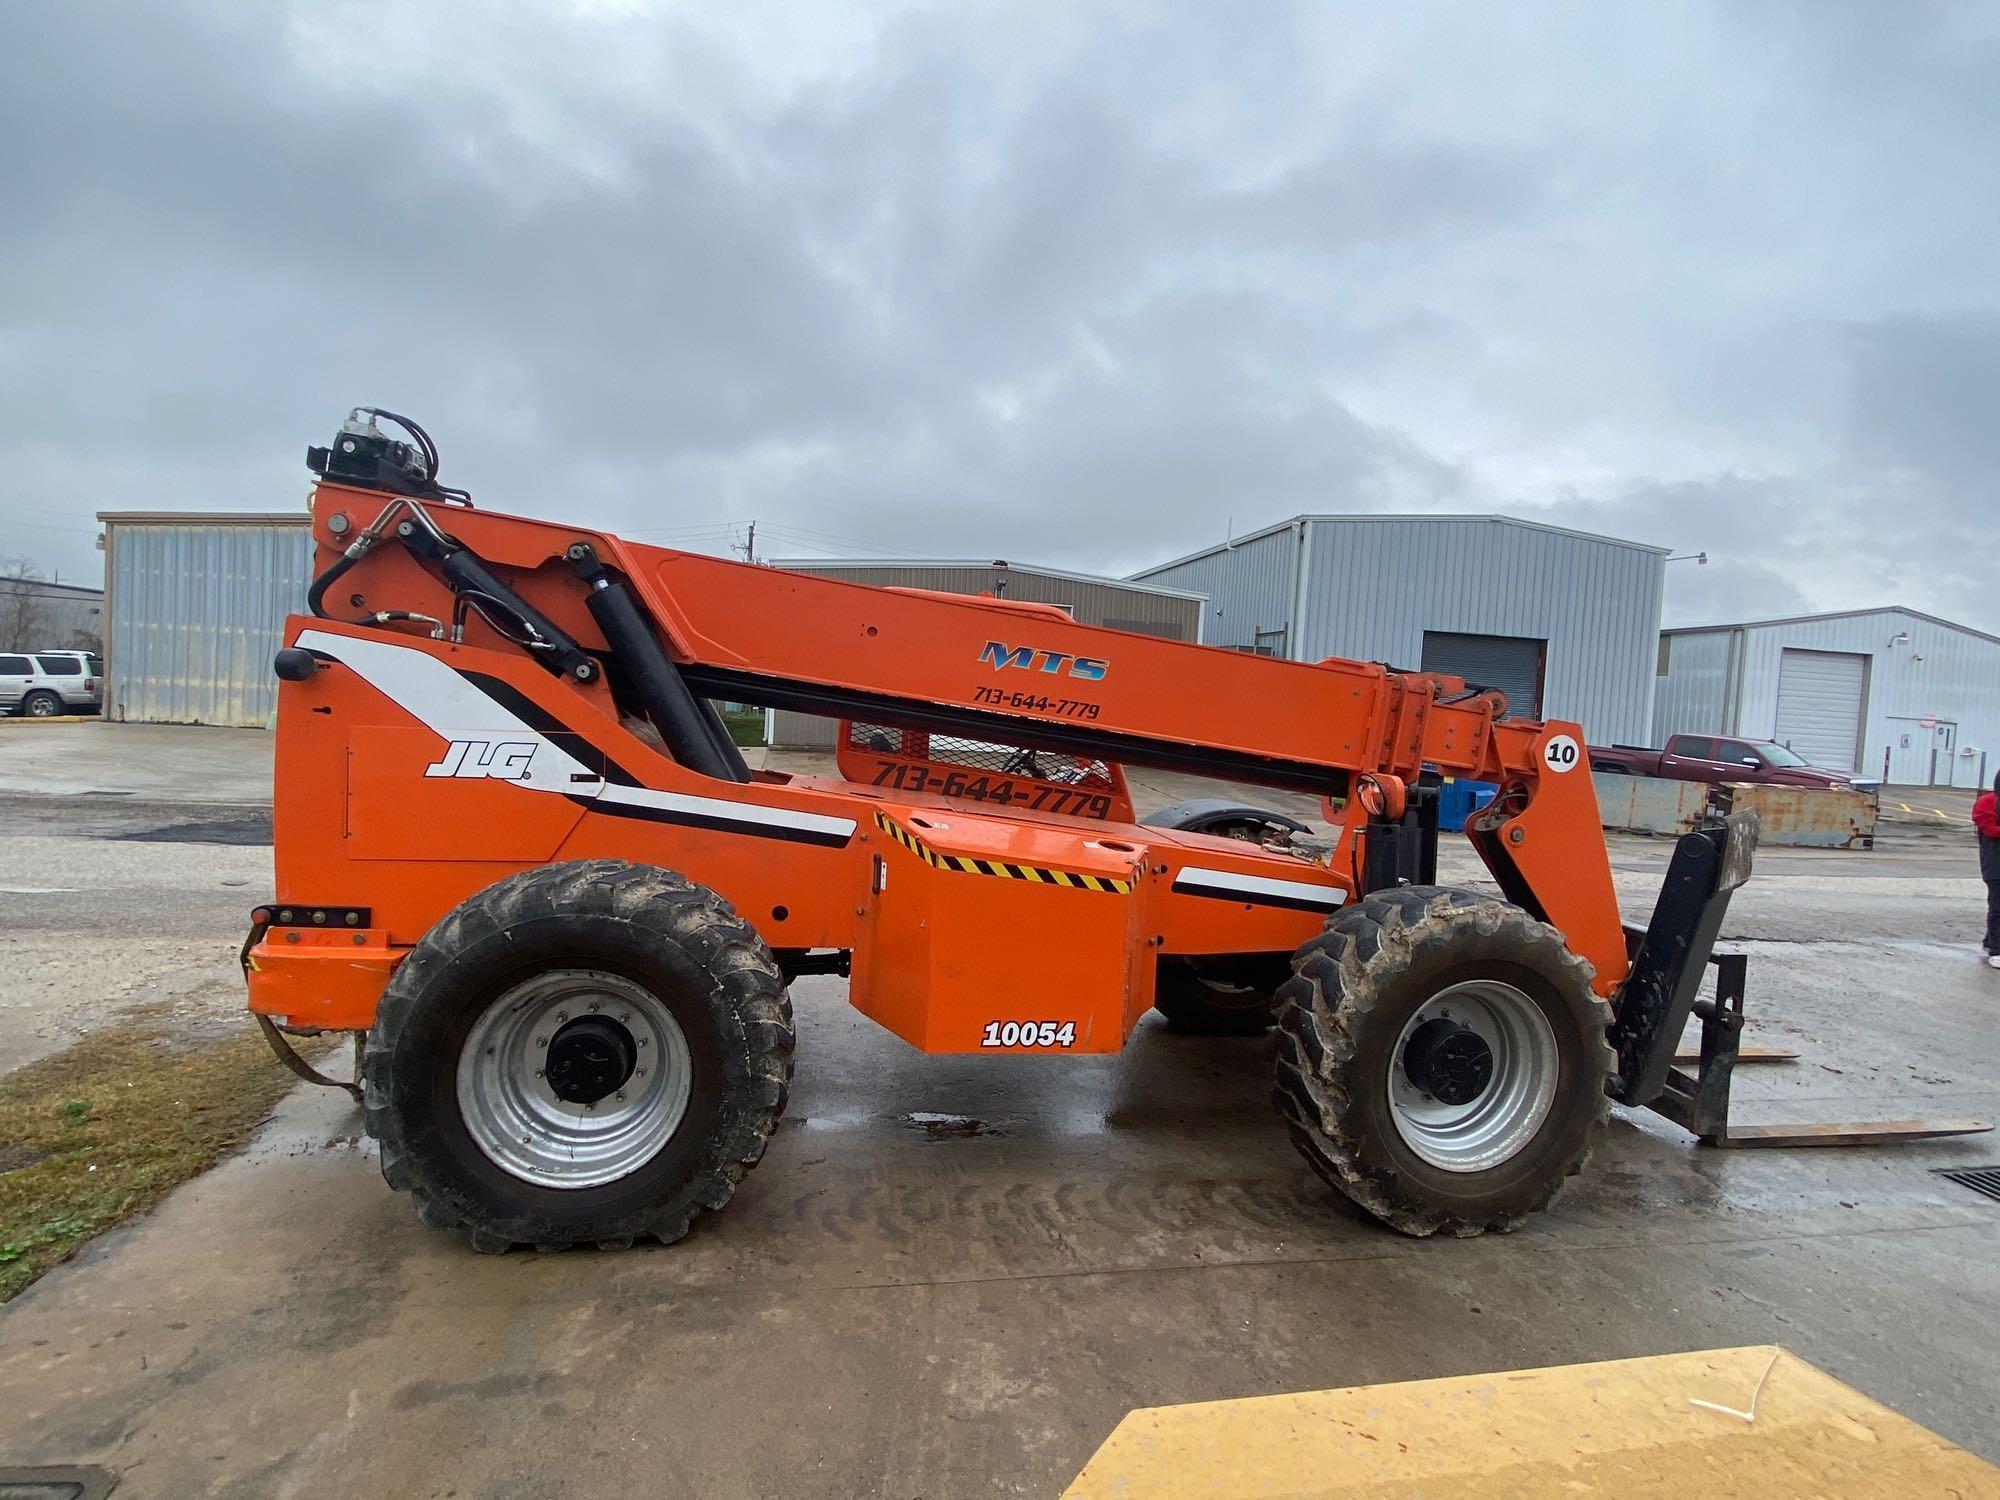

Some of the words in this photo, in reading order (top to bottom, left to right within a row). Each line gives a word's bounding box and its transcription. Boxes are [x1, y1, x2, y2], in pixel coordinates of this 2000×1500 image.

[978, 641, 1109, 681] MTS
[974, 686, 1100, 719] 713-644-7779
[424, 741, 538, 779] JLG
[1548, 744, 1576, 763] 10
[873, 762, 1111, 819] 713-644-7779
[981, 1020, 1077, 1047] 10054
